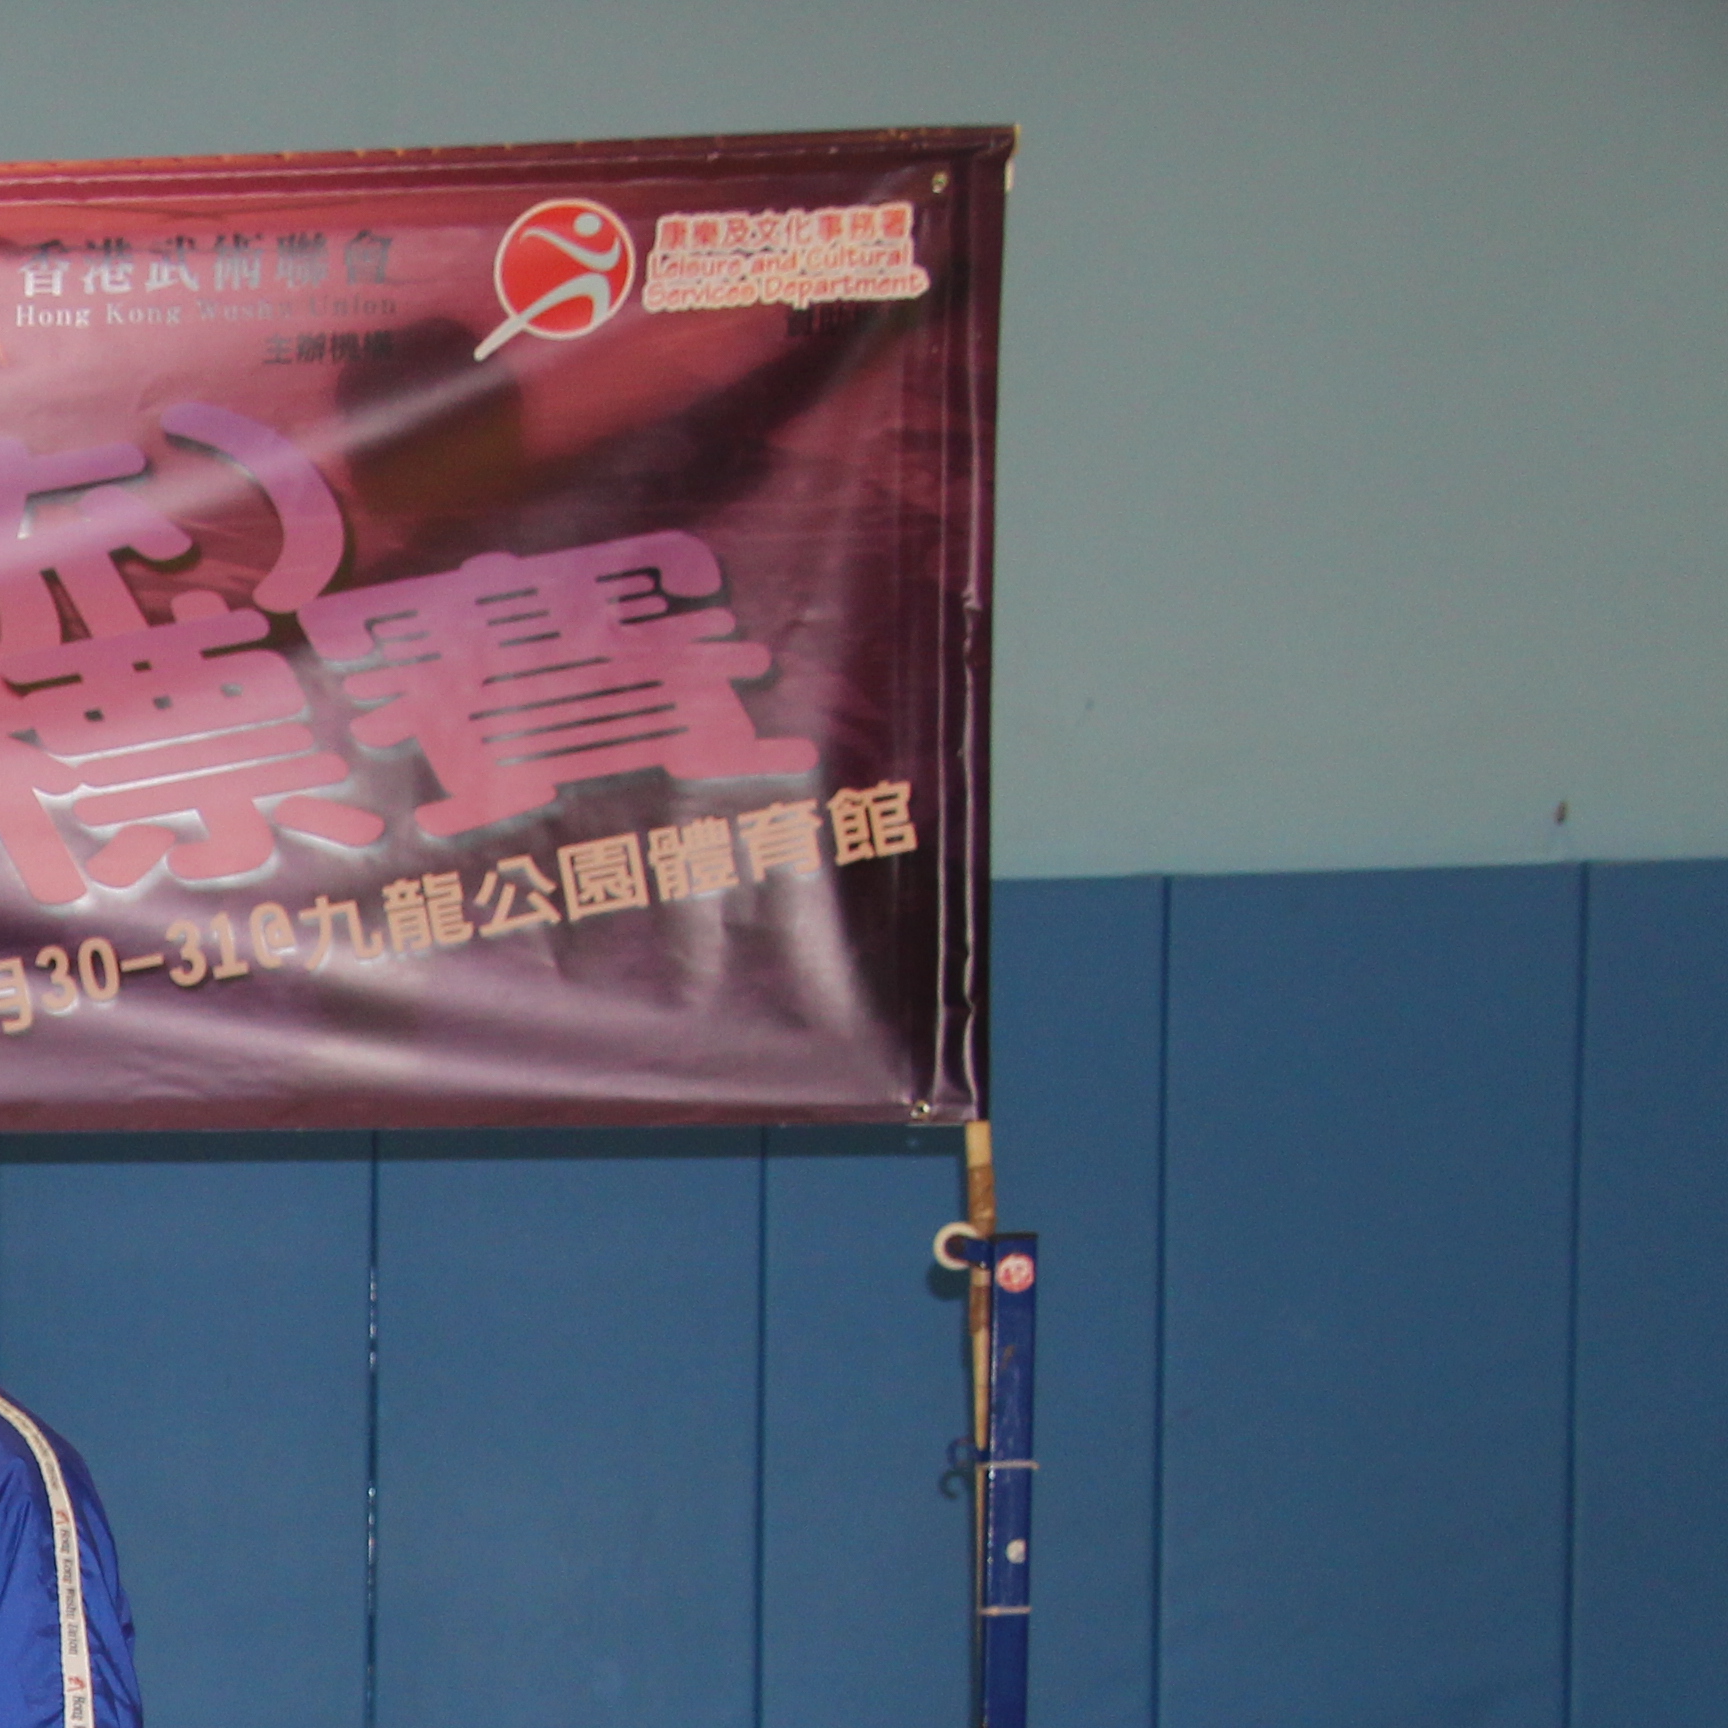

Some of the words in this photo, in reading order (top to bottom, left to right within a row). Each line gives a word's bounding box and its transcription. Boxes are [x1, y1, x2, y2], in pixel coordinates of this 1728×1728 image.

[651, 252, 746, 279] Leisure
[750, 250, 800, 273] and
[805, 243, 910, 271] Cultural
[646, 281, 757, 305] Services
[764, 272, 923, 308] Department
[16, 302, 91, 328] Hong
[104, 301, 182, 327] Kong
[71, 1695, 85, 1722] Hong
